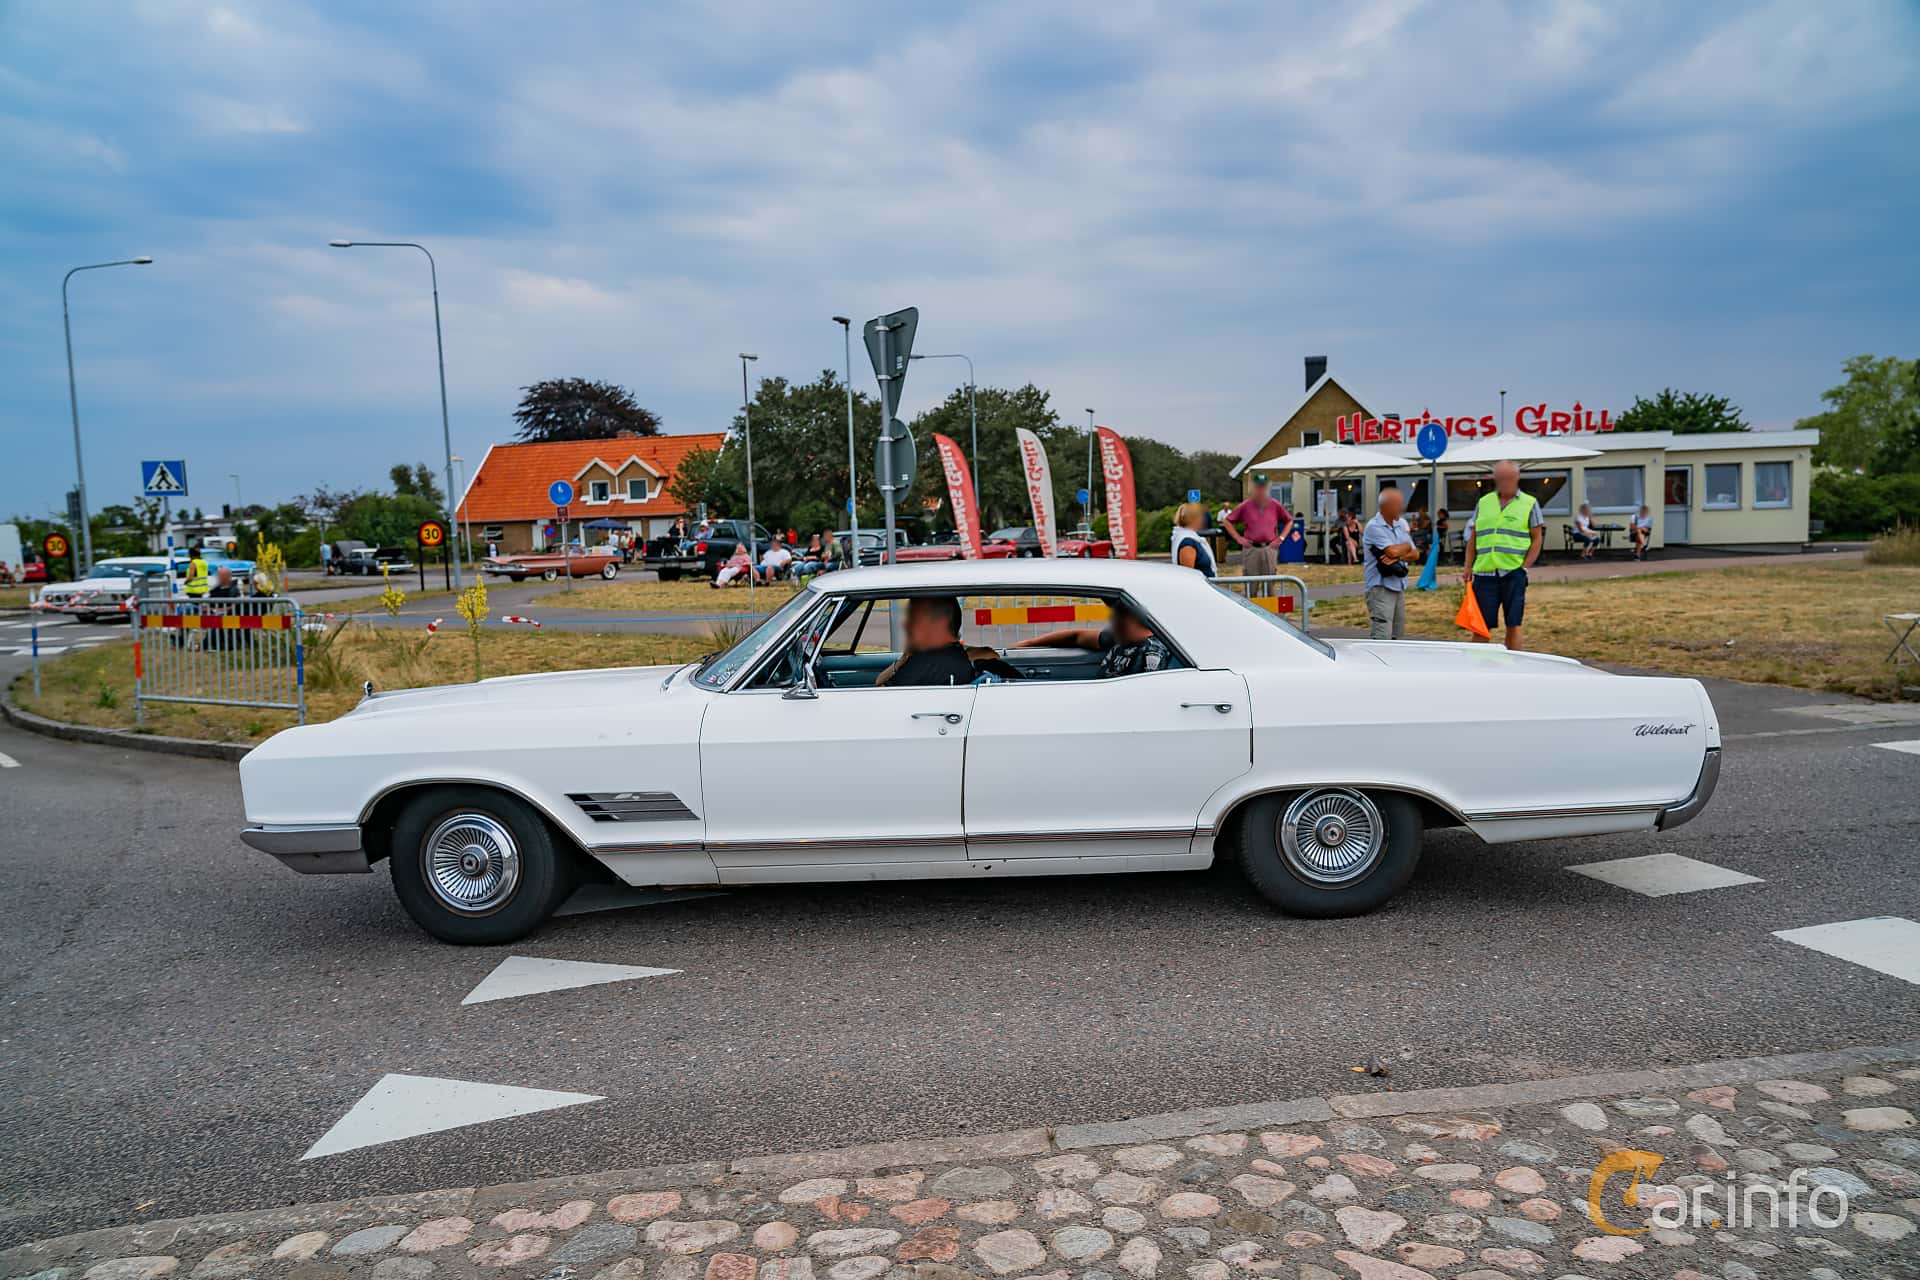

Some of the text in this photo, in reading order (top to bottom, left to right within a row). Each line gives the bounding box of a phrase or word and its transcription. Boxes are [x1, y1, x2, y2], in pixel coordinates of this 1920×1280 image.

[1515, 401, 1616, 437] GRILL
[424, 528, 440, 540] 30
[48, 540, 64, 552] 30
[1632, 723, 1697, 736] Wildcat
